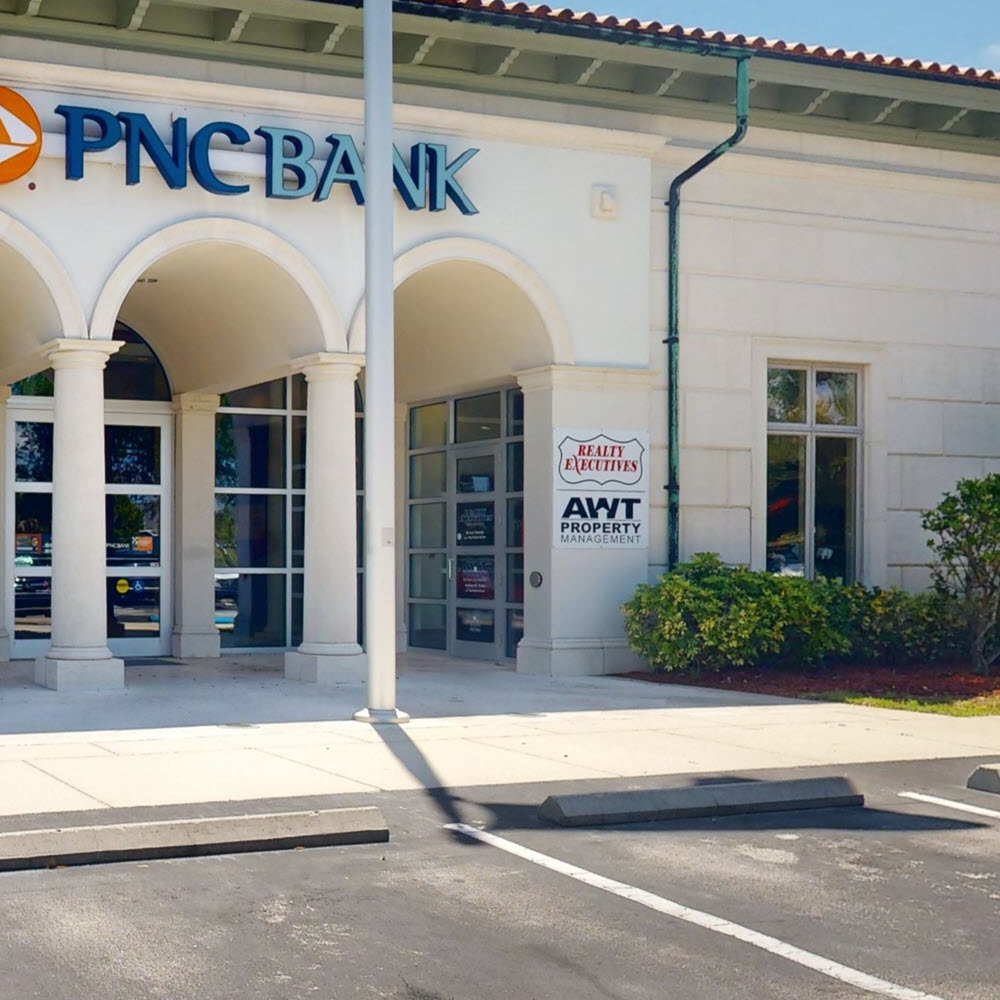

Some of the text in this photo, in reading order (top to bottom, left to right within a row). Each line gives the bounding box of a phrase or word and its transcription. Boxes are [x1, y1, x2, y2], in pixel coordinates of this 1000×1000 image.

[54, 104, 480, 216] PNC BANK
[577, 444, 626, 458] REALTY
[564, 455, 638, 475] EXECUTIVES
[561, 497, 642, 520] AWT
[560, 522, 641, 534] PROPERTY
[560, 534, 641, 544] MANAGEMENT
